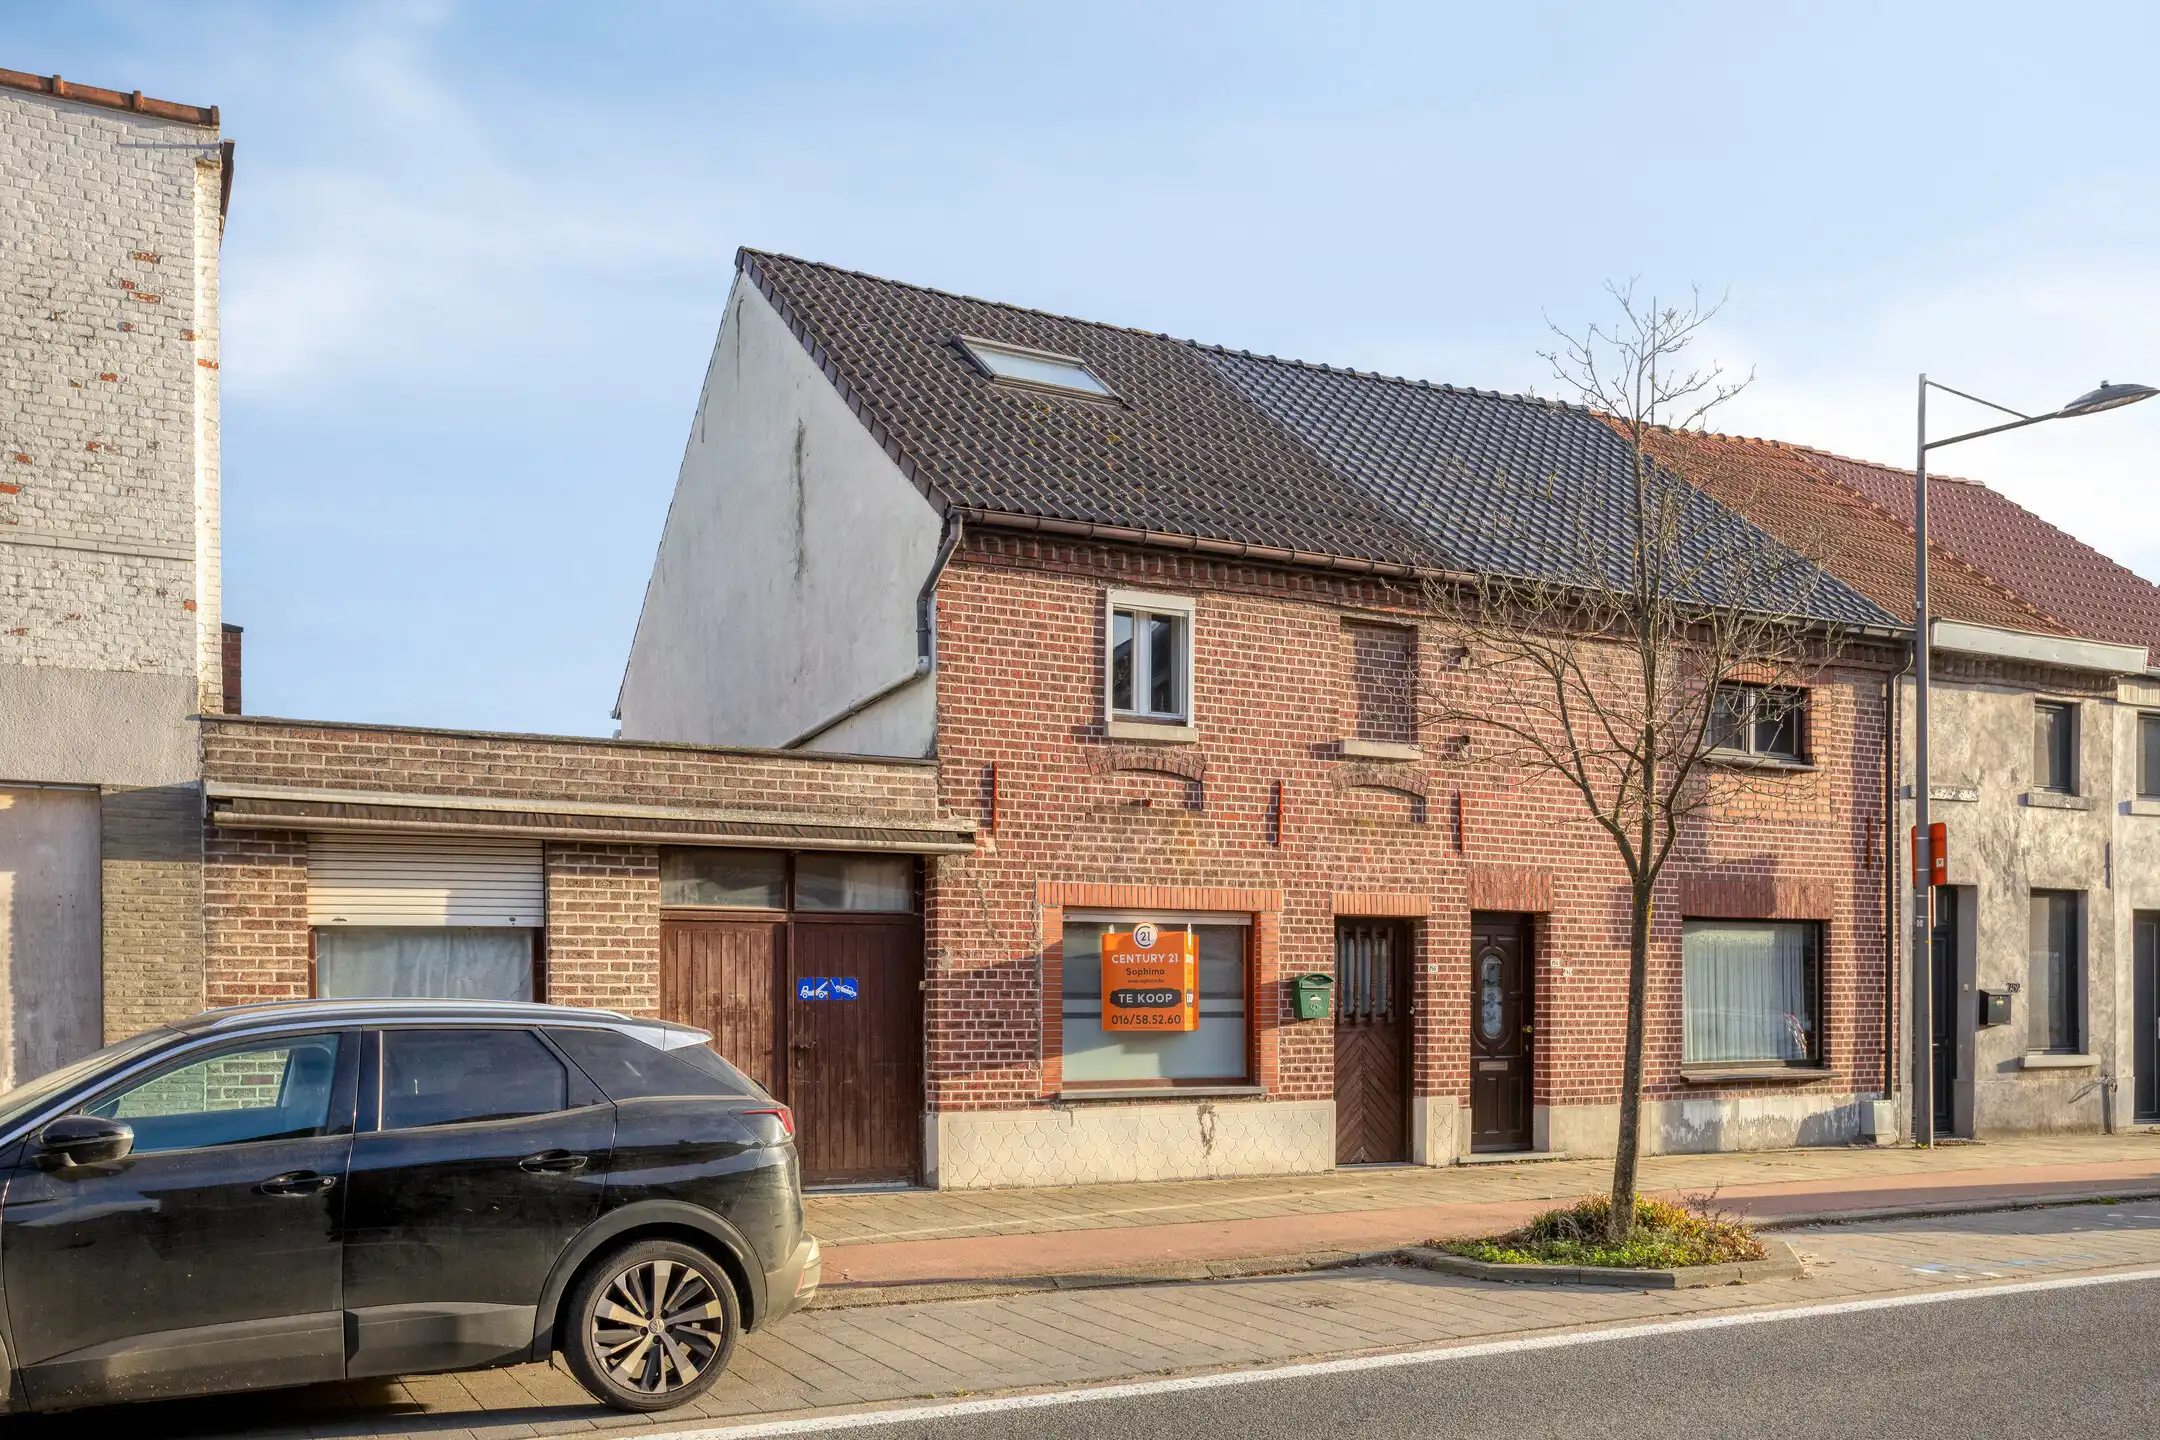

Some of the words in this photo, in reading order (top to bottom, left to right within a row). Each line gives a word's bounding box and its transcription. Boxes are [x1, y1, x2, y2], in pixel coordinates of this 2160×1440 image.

[1111, 954, 1165, 964] CENTURY
[1168, 954, 1179, 963] 21
[1126, 968, 1165, 977] Sophimo
[1118, 994, 1133, 1003] TE
[1137, 993, 1173, 1003] KOOP
[1111, 1015, 1181, 1025] 016/58.52.60
